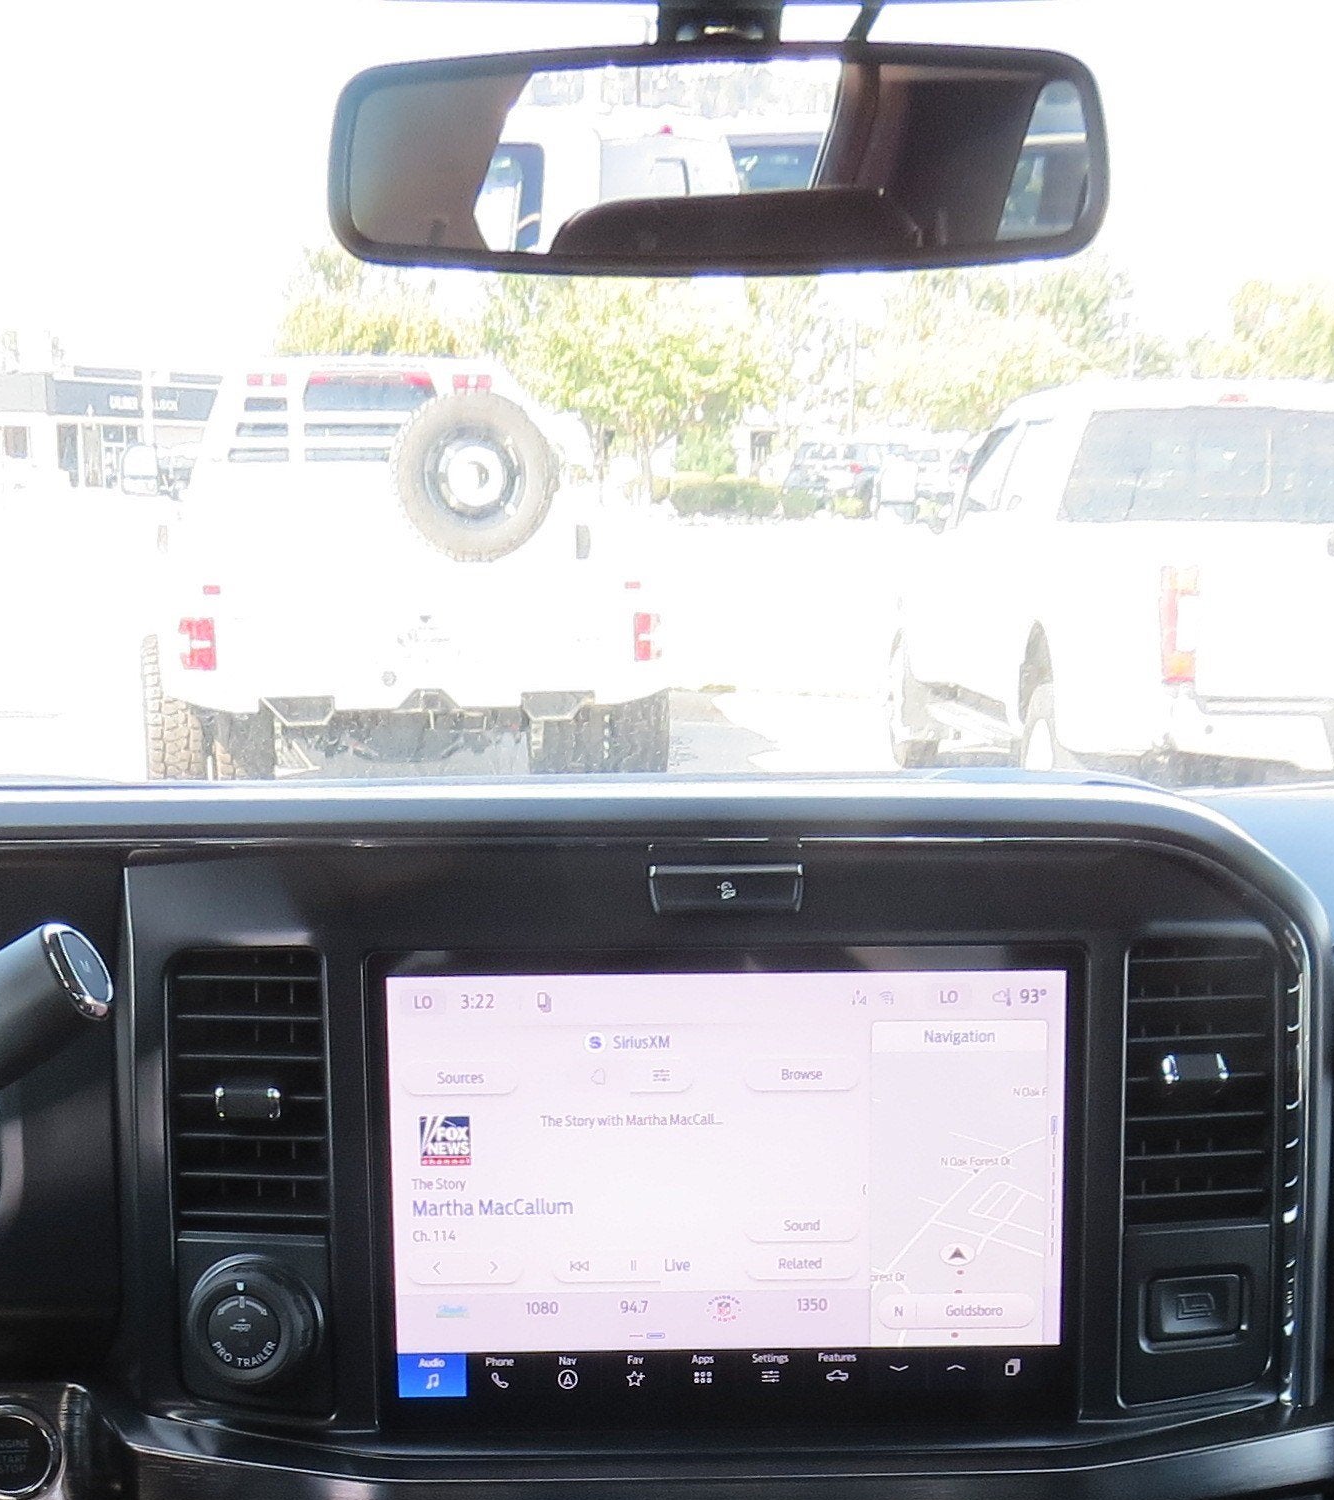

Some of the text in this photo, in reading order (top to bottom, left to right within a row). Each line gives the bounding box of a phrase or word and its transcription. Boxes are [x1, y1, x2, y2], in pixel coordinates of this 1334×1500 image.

[414, 995, 433, 1010] LO
[460, 994, 495, 1010] 3:22
[940, 990, 959, 1004] LO
[612, 1035, 671, 1050] SiriusXM
[923, 1029, 997, 1046] Navigation
[436, 1071, 485, 1085] Sources
[781, 1067, 823, 1081] Browse
[540, 1115, 562, 1128] The
[565, 1115, 595, 1130] Story
[597, 1114, 624, 1127] with
[626, 1114, 669, 1127] Martha
[435, 1126, 470, 1141] FOX
[426, 1141, 471, 1155] NEWS
[411, 1178, 467, 1193] The Story
[412, 1198, 574, 1217] Martha MacCallum
[783, 1219, 821, 1233] Sound
[433, 1230, 457, 1243] 114
[664, 1259, 691, 1273] Live
[778, 1257, 823, 1271] Related
[525, 1301, 560, 1316] 1080
[620, 1300, 650, 1315] 94.7
[796, 1297, 828, 1312] 1350
[945, 1304, 1004, 1318] Goldsboro
[210, 1340, 278, 1368] PRO TRAILER
[558, 1355, 577, 1367] Nav
[626, 1355, 645, 1366] Fav
[691, 1354, 715, 1368] Apps
[752, 1352, 790, 1366] Settings
[817, 1351, 857, 1364] Features
[418, 1357, 446, 1369] Audio
[485, 1356, 515, 1368] Phone
